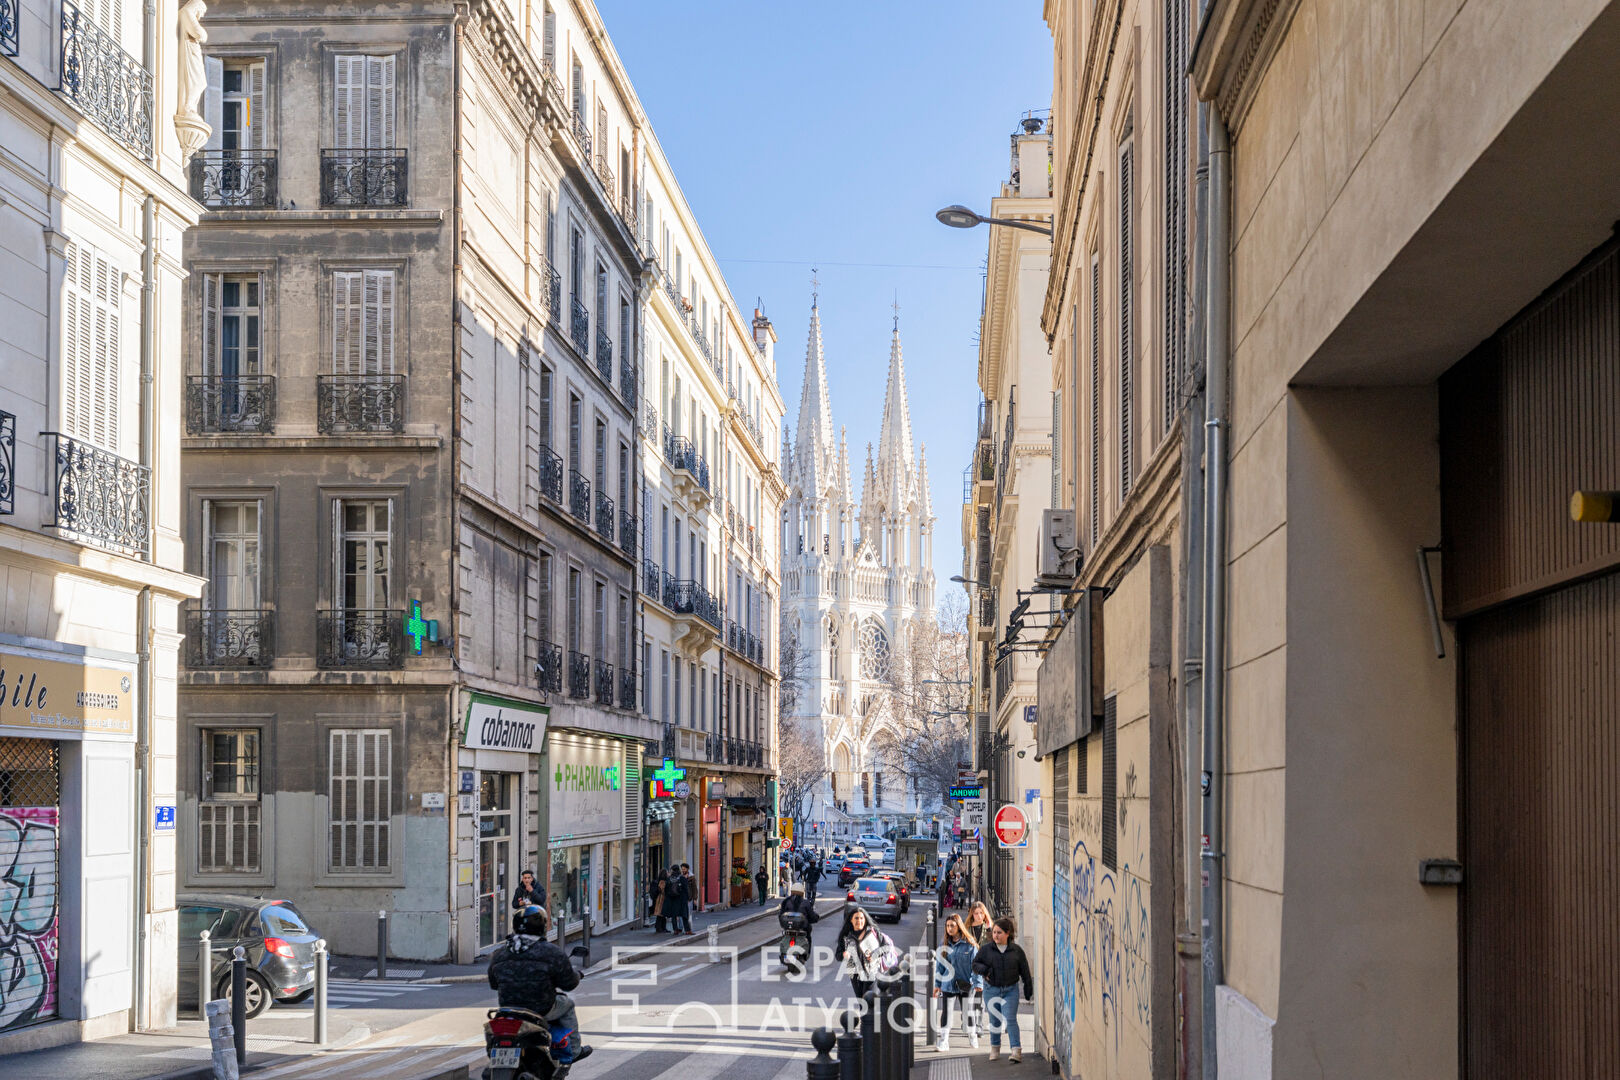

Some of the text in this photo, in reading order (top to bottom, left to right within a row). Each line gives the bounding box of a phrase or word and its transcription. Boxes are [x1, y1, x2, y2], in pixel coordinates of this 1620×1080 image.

[76, 692, 119, 709] ACCESSOIRES
[481, 709, 536, 750] cobannos
[564, 763, 618, 792] PHARMACIE
[966, 801, 986, 812] COIFFEUR
[970, 814, 983, 825] MIXTE
